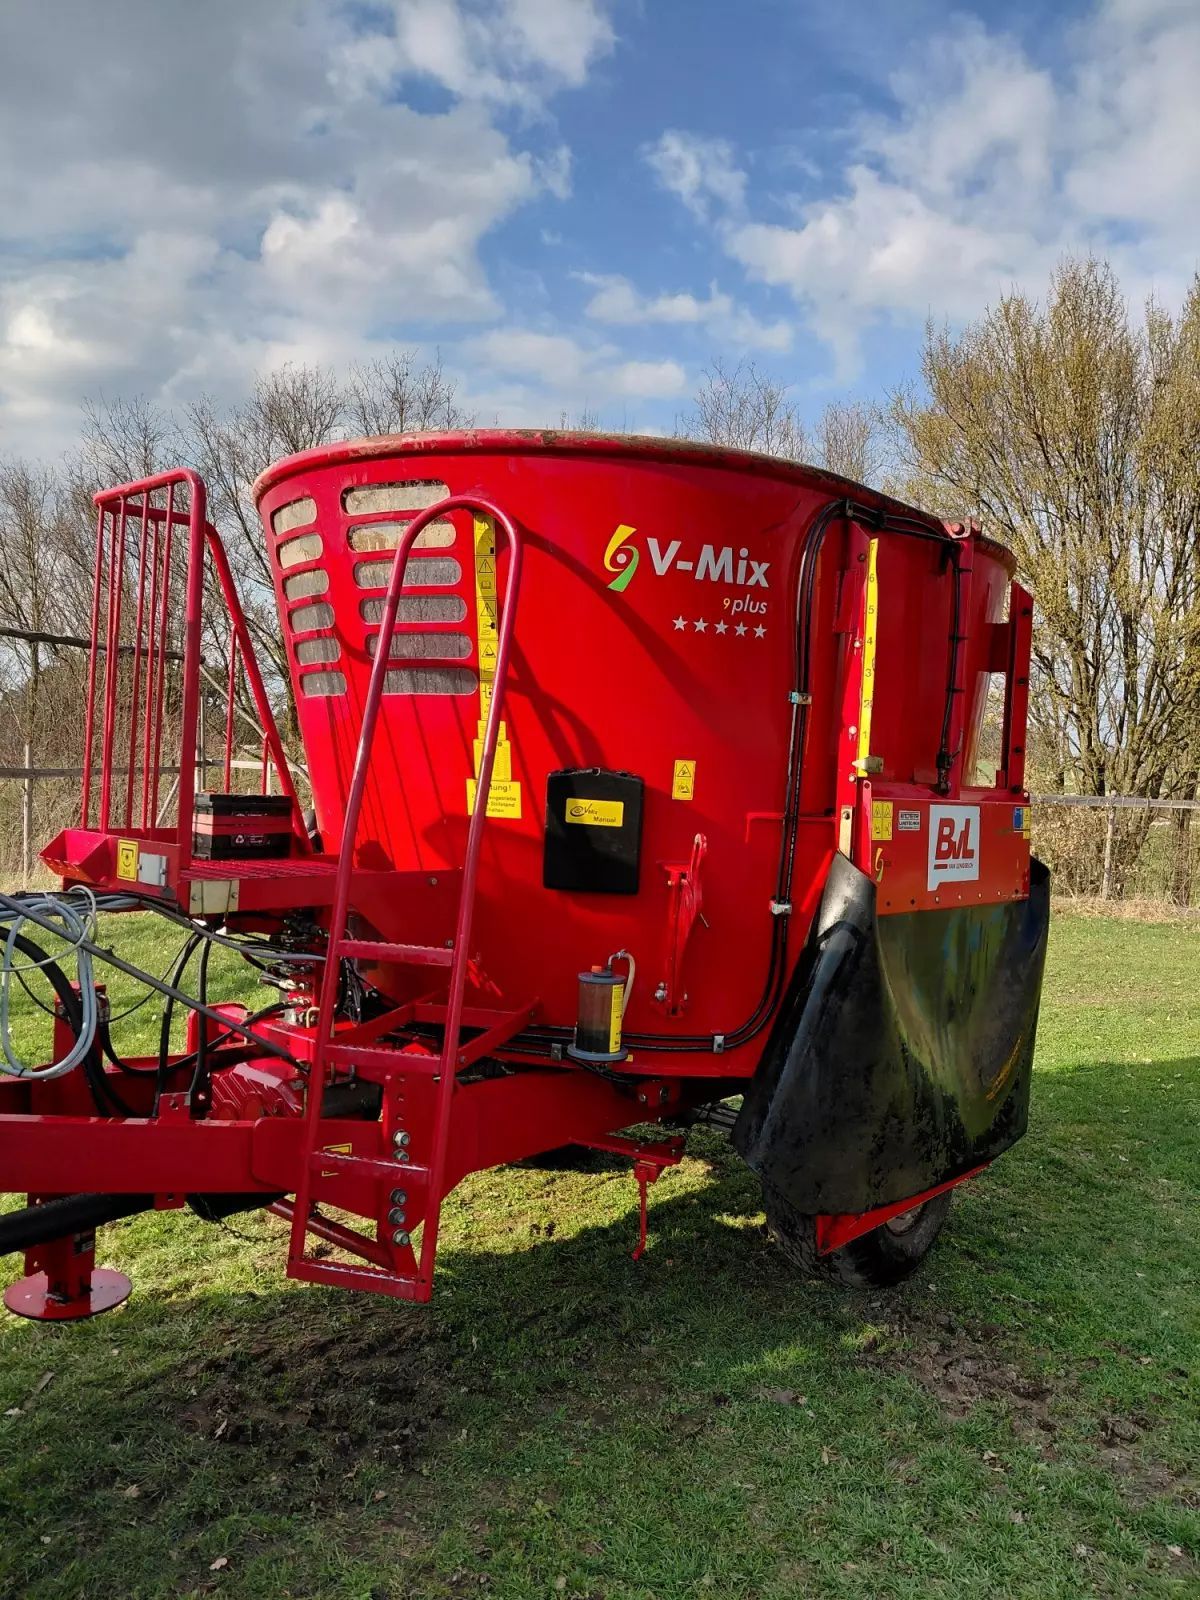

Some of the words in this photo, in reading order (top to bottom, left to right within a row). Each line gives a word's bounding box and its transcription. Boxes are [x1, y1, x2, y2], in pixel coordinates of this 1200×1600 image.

[647, 537, 770, 588] V-Mix
[869, 573, 875, 583] 6
[868, 605, 875, 614] 5
[866, 636, 873, 645] 4
[865, 668, 872, 677] 3
